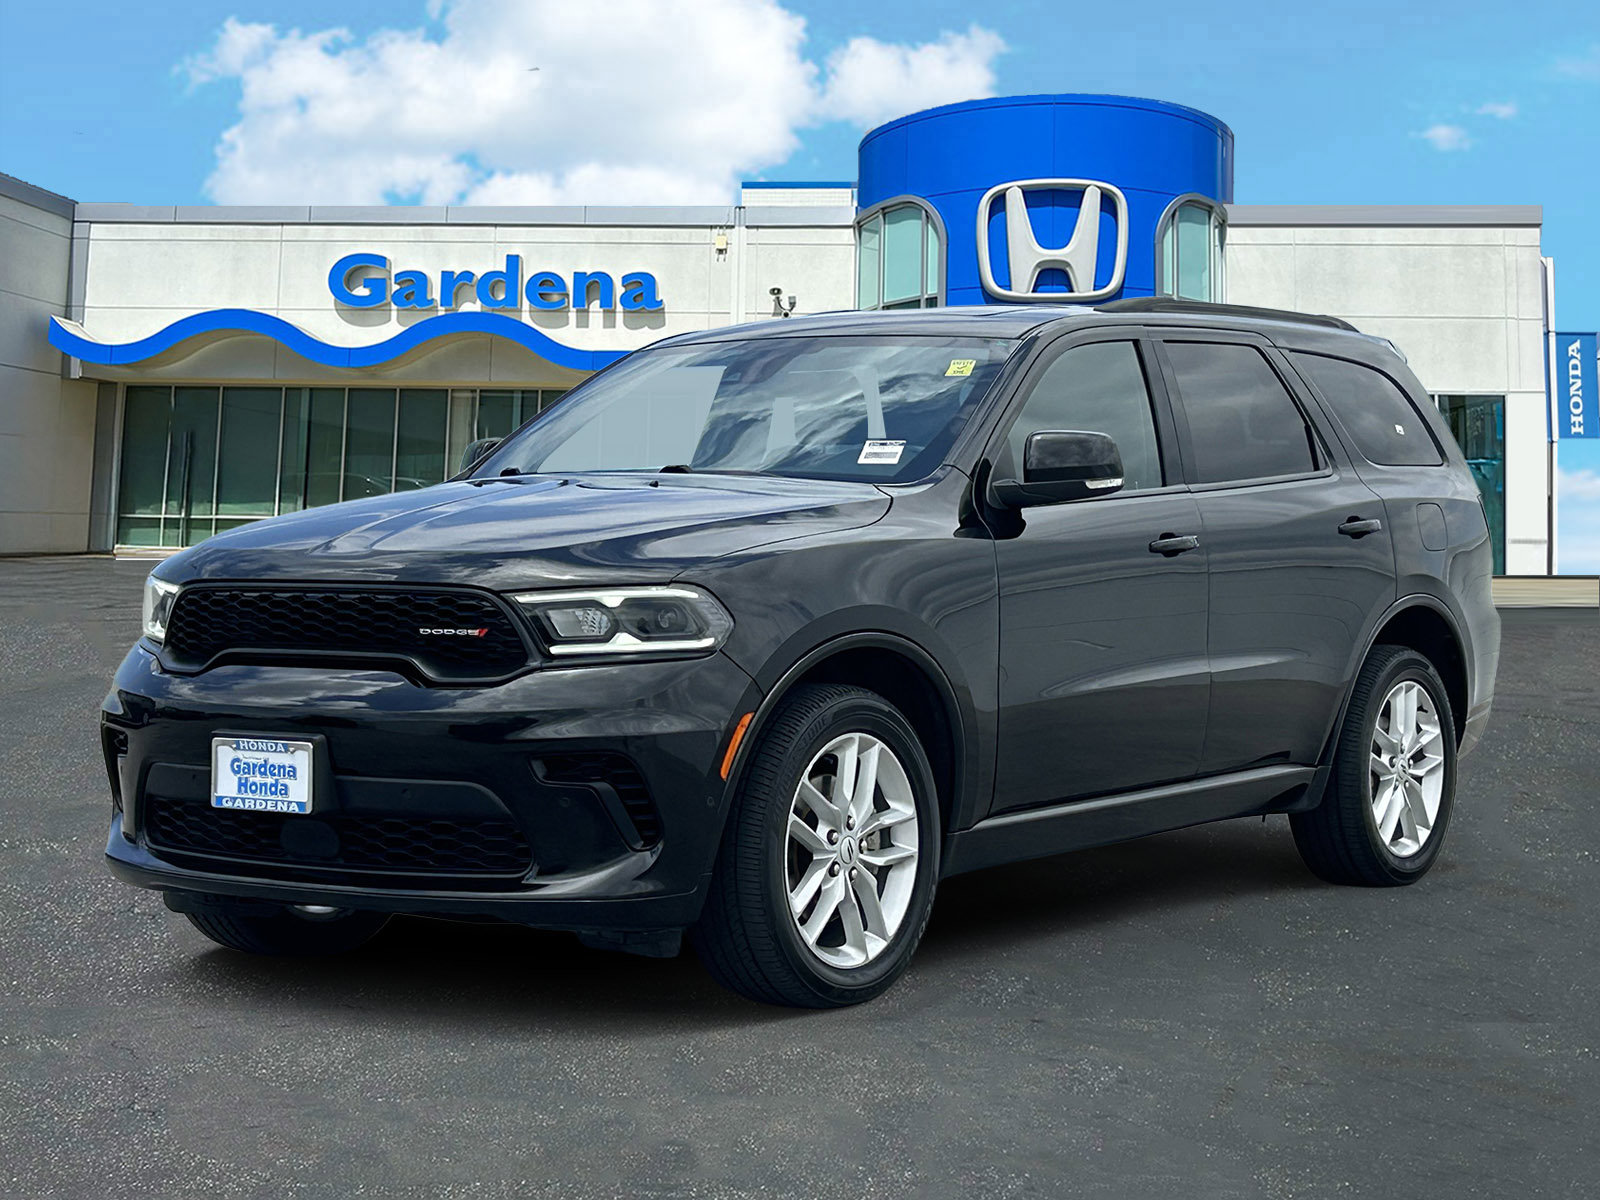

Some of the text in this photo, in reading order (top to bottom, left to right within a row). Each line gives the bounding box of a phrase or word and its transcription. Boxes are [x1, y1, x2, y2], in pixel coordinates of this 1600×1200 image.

[328, 253, 664, 311] Gardena
[1568, 339, 1584, 435] HONDA
[419, 628, 479, 636] DODGE
[239, 740, 285, 753] HONDA
[230, 758, 297, 779] Gardena
[237, 777, 289, 797] Honda
[222, 798, 299, 812] GARDENA
